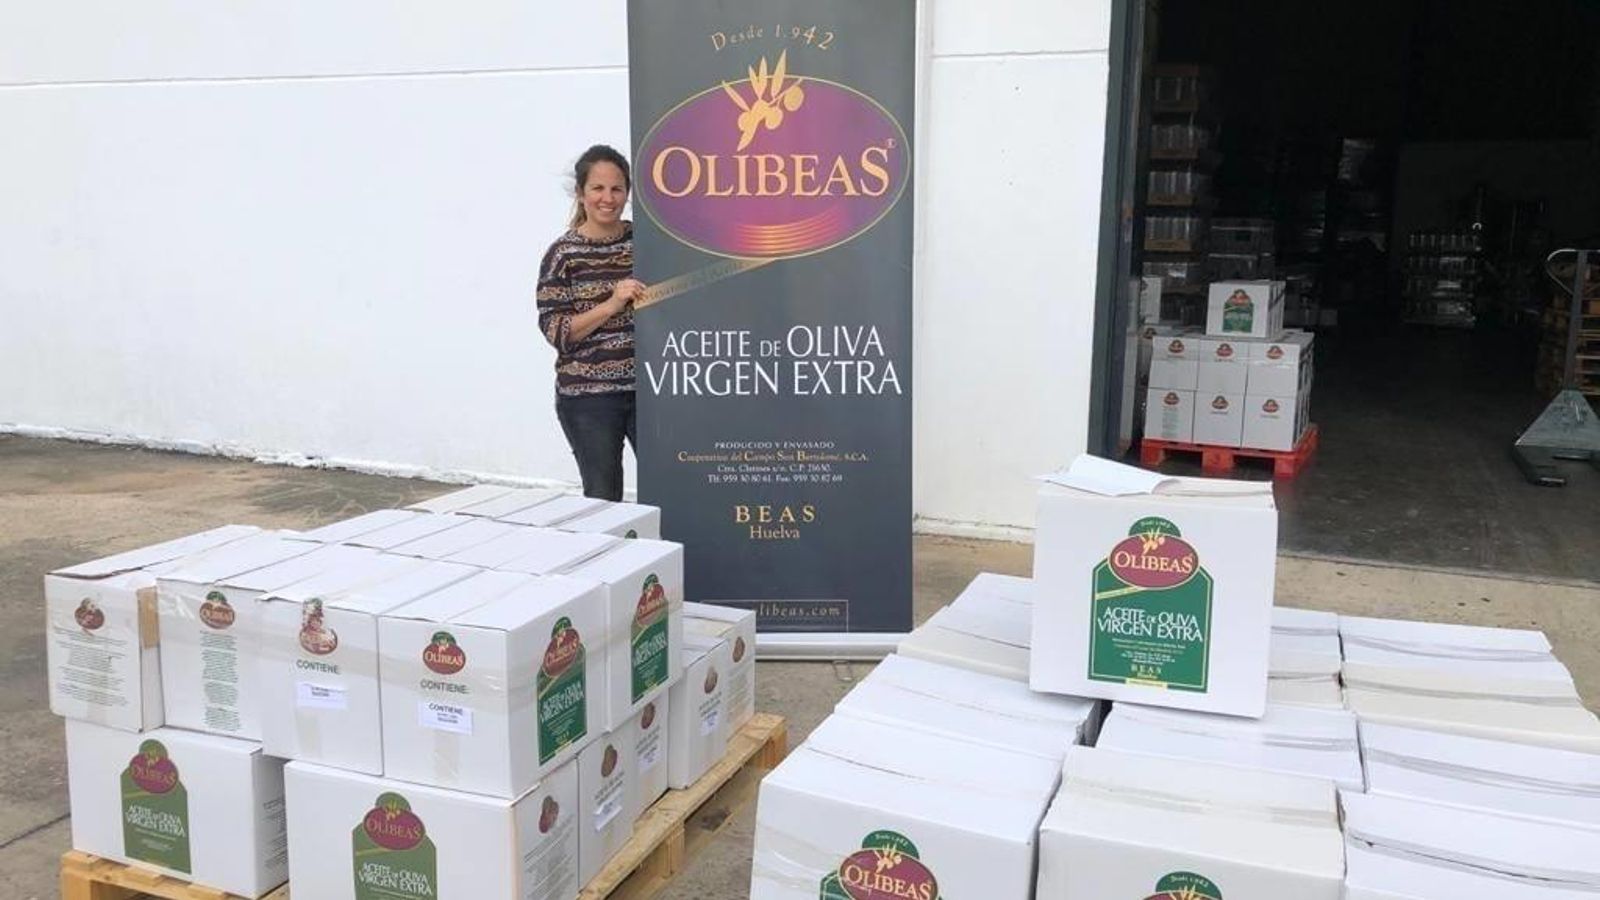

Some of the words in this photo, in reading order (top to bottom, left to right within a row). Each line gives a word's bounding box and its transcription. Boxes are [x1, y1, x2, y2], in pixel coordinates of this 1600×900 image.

[711, 24, 764, 51] Desde
[662, 330, 751, 358] ACEITE
[759, 340, 782, 357] DE
[787, 325, 885, 357] OLIVA
[645, 361, 778, 396] VIRGEN
[794, 361, 902, 395] EXTRA
[714, 441, 772, 449] PRODUCIDO
[774, 441, 781, 449] Y
[783, 441, 835, 449] ENVASADO
[735, 505, 816, 523] BEAS
[749, 524, 801, 539] Huelva
[1114, 550, 1193, 575] OLIBEAS
[755, 602, 841, 618] libeas.com
[1102, 606, 1146, 624] ACEITE
[1158, 611, 1199, 628] OLIVA
[1097, 617, 1153, 637] VIRGEN
[1157, 624, 1204, 642] EXTRA
